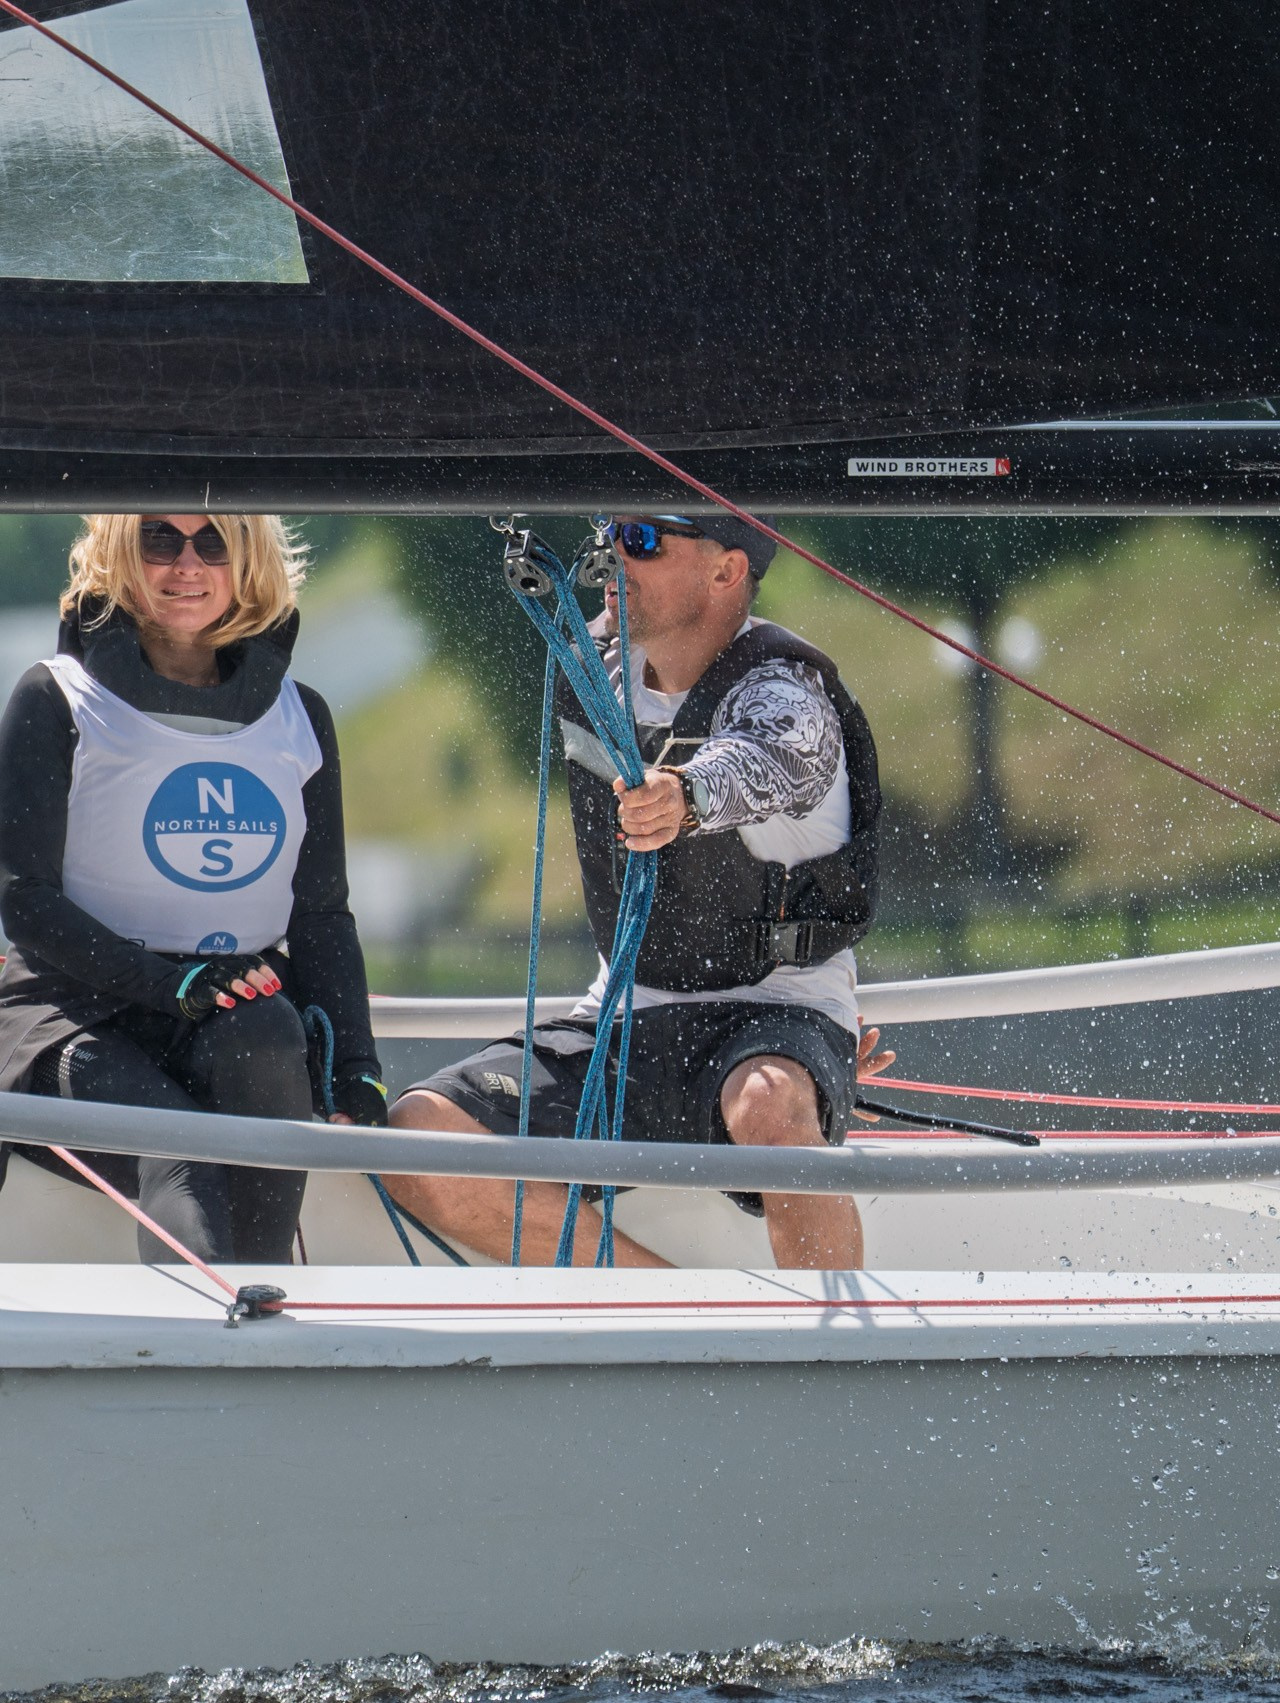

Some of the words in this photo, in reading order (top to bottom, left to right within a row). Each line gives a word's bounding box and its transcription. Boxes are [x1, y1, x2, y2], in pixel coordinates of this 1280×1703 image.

[856, 461, 898, 472] WIND
[905, 461, 988, 472] BROTHERS
[197, 777, 235, 814] N
[154, 819, 219, 832] NORTH
[227, 820, 278, 832] SAILS
[199, 838, 234, 877] S
